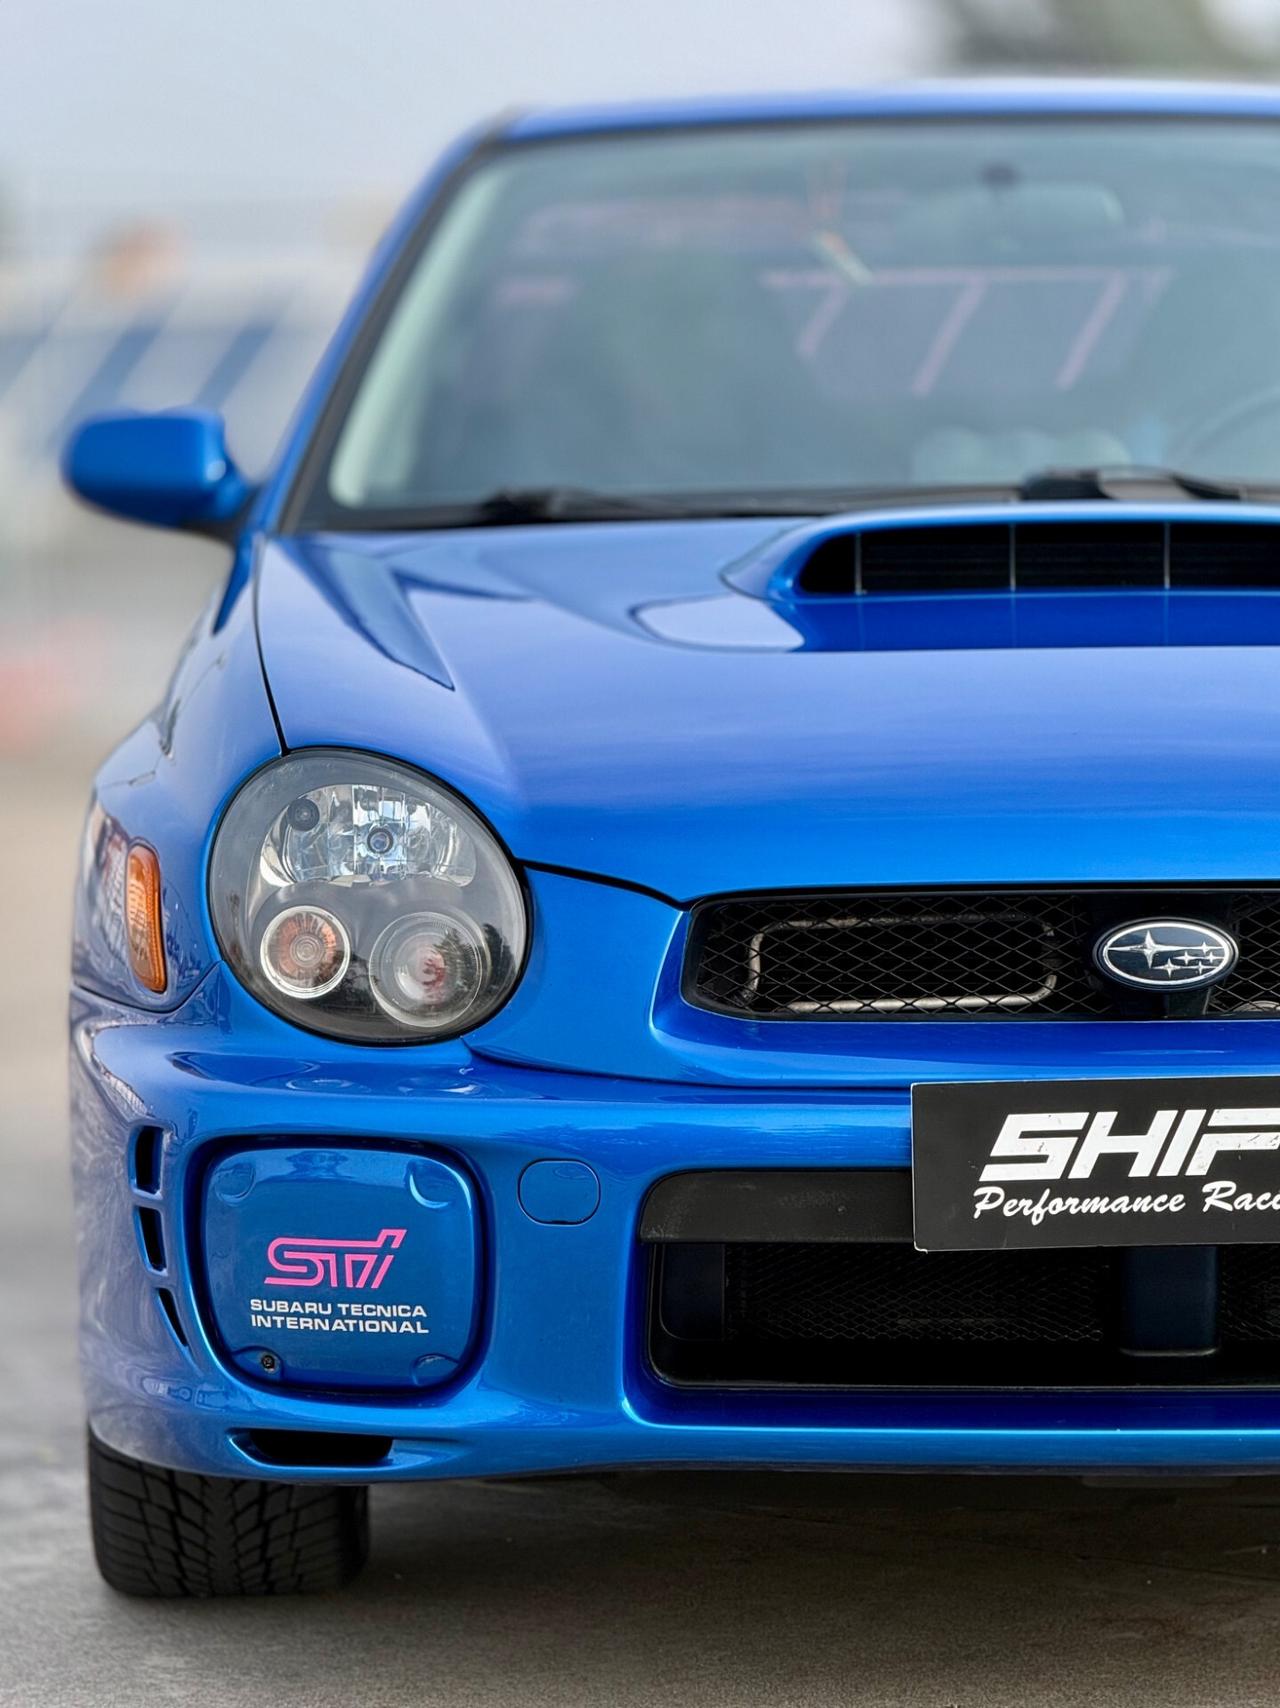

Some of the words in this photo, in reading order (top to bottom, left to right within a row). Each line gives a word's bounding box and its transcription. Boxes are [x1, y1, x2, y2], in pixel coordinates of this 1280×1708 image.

[973, 1186, 1186, 1226] Performance
[250, 1298, 332, 1316] SUBARU
[337, 1303, 427, 1318] TECNICA
[251, 1314, 429, 1334] INTERNATIONAL
